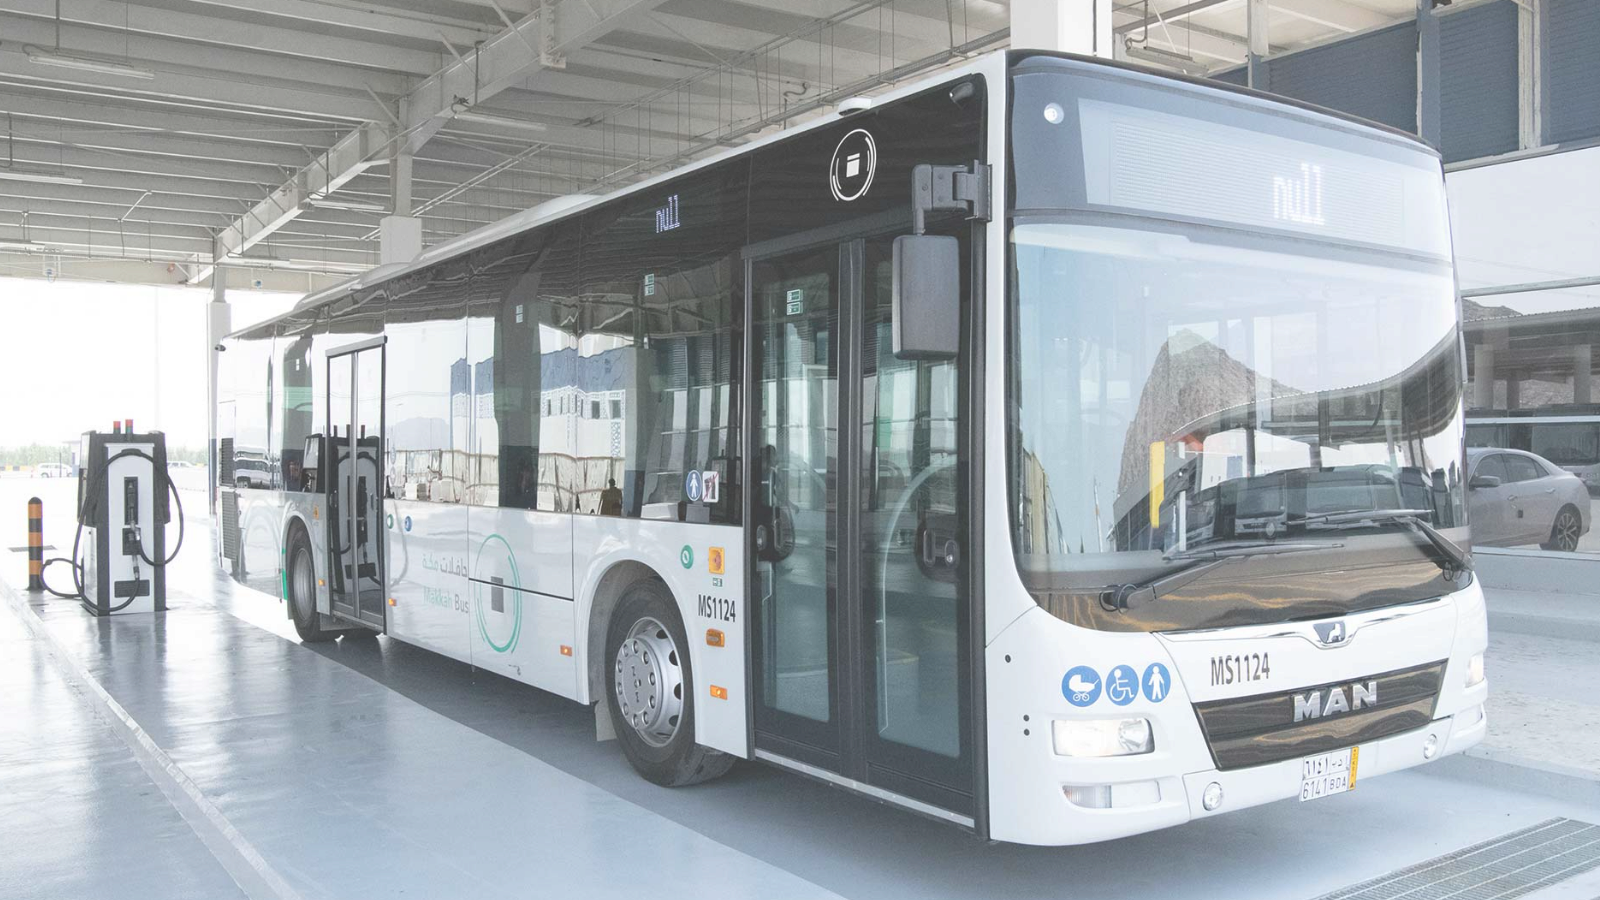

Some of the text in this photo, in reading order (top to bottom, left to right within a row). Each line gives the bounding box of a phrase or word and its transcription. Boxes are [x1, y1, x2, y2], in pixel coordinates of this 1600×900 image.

[1273, 163, 1325, 225] null
[655, 194, 680, 233] null
[422, 551, 468, 577] حافلات مكة
[423, 585, 469, 613] Makkah Bus
[698, 594, 736, 623] MS1124
[1211, 652, 1270, 686] MS1124
[1293, 681, 1377, 722] MAN
[1302, 776, 1346, 799] 6141 BDA
